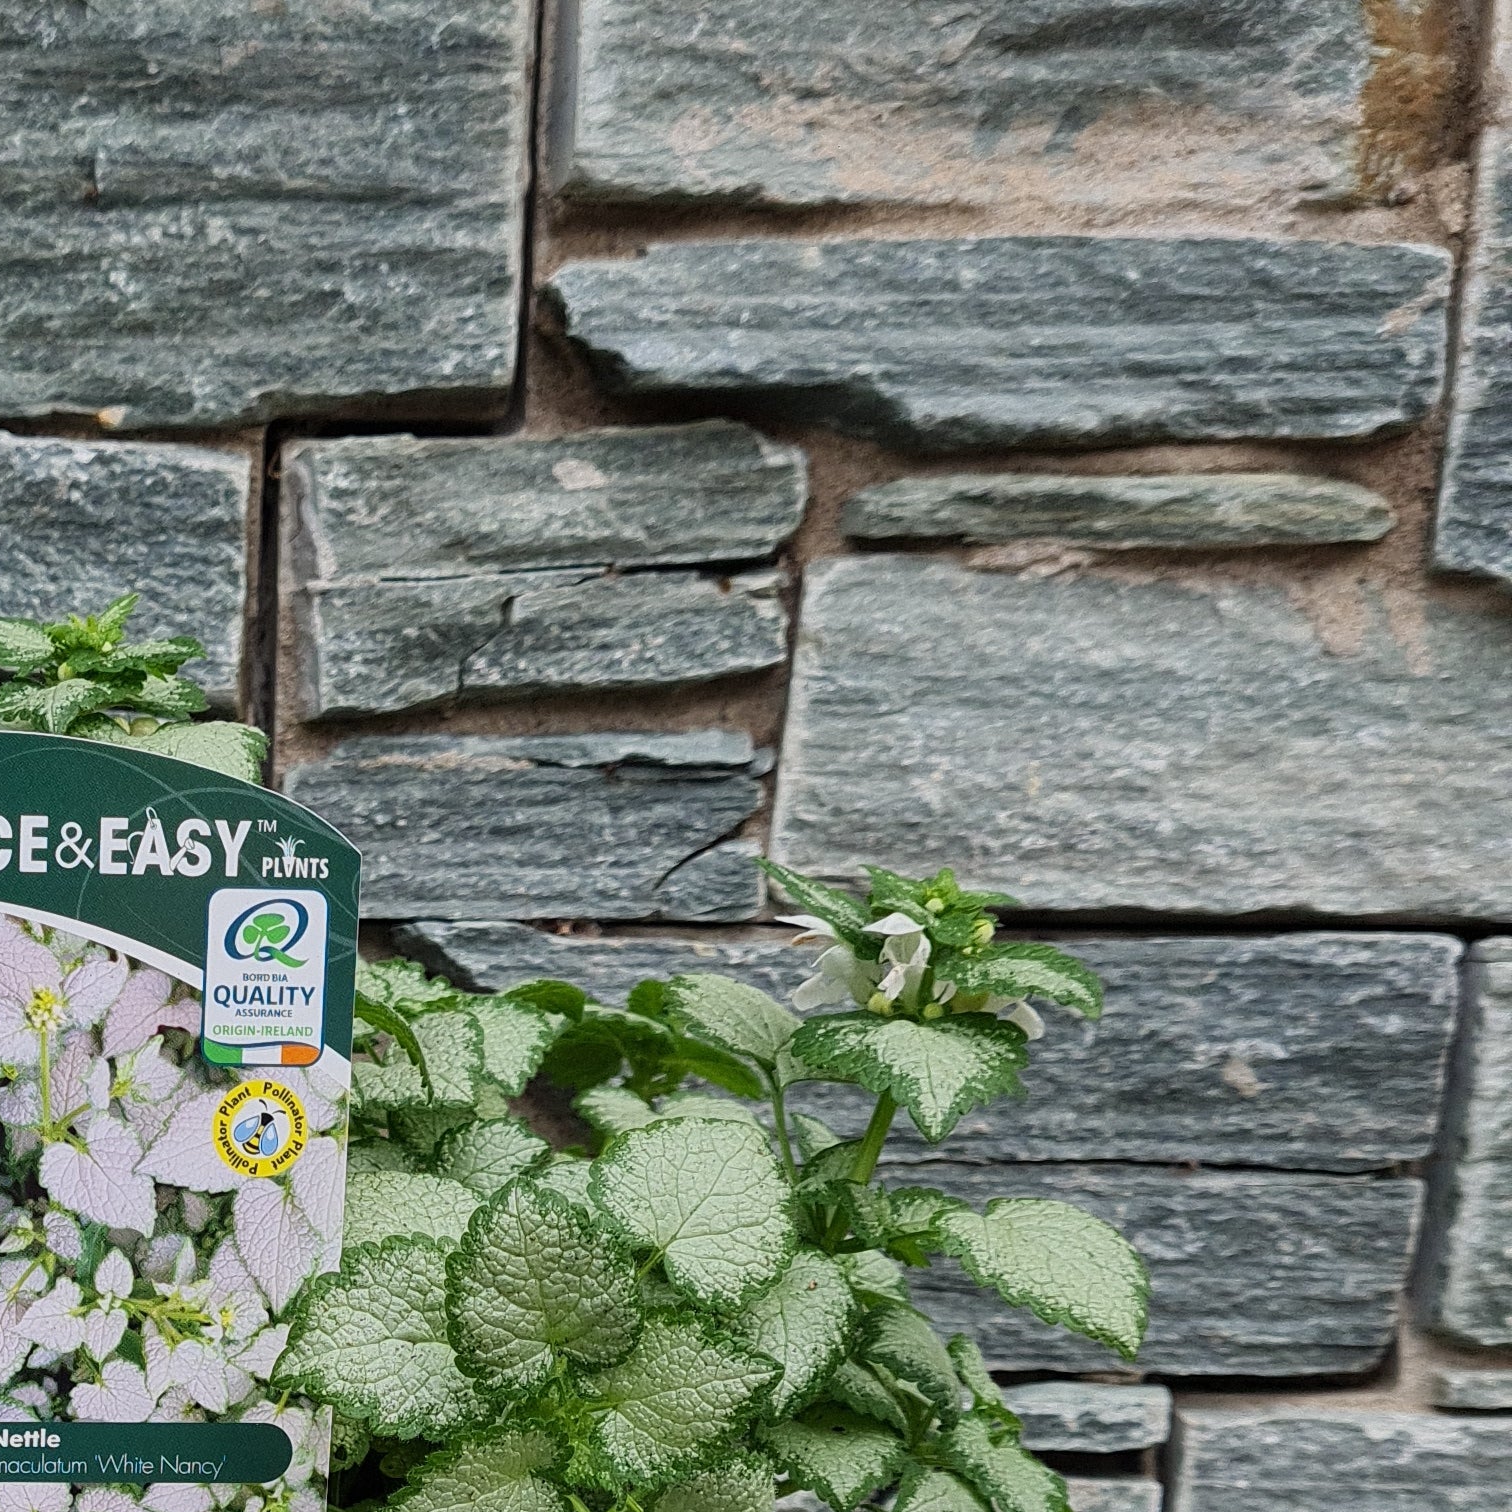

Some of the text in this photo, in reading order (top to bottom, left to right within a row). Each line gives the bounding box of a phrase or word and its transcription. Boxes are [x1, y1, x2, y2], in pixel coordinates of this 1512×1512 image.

[243, 973, 288, 982] BORD BIA
[213, 985, 315, 1007] QUALITY
[235, 1009, 293, 1017] ASSURANCE
[213, 1024, 313, 1037] ORIGIN-IRELAND
[218, 1087, 258, 1175] Pollinator Plant
[263, 1082, 304, 1170] Pollinator Plant
